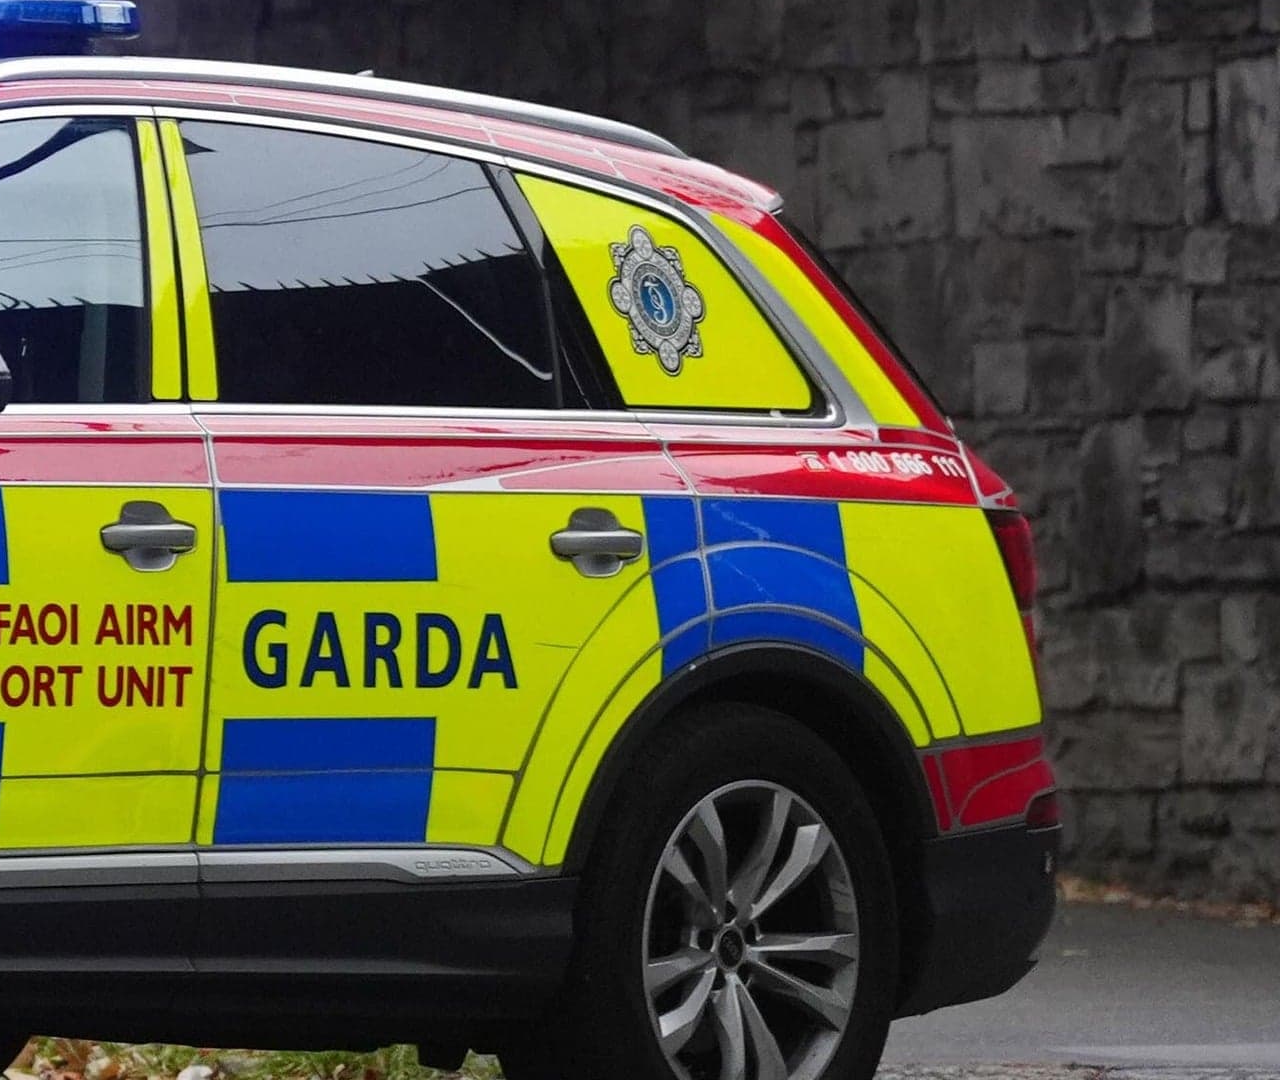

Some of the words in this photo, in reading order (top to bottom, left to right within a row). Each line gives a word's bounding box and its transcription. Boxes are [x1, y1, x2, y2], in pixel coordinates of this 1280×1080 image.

[827, 451, 847, 472] 1
[846, 451, 891, 473] 800
[890, 452, 934, 475] 666
[931, 455, 967, 478] 111
[95, 604, 193, 647] AIRM
[242, 609, 519, 689] GARDA
[96, 666, 193, 708] UNIT
